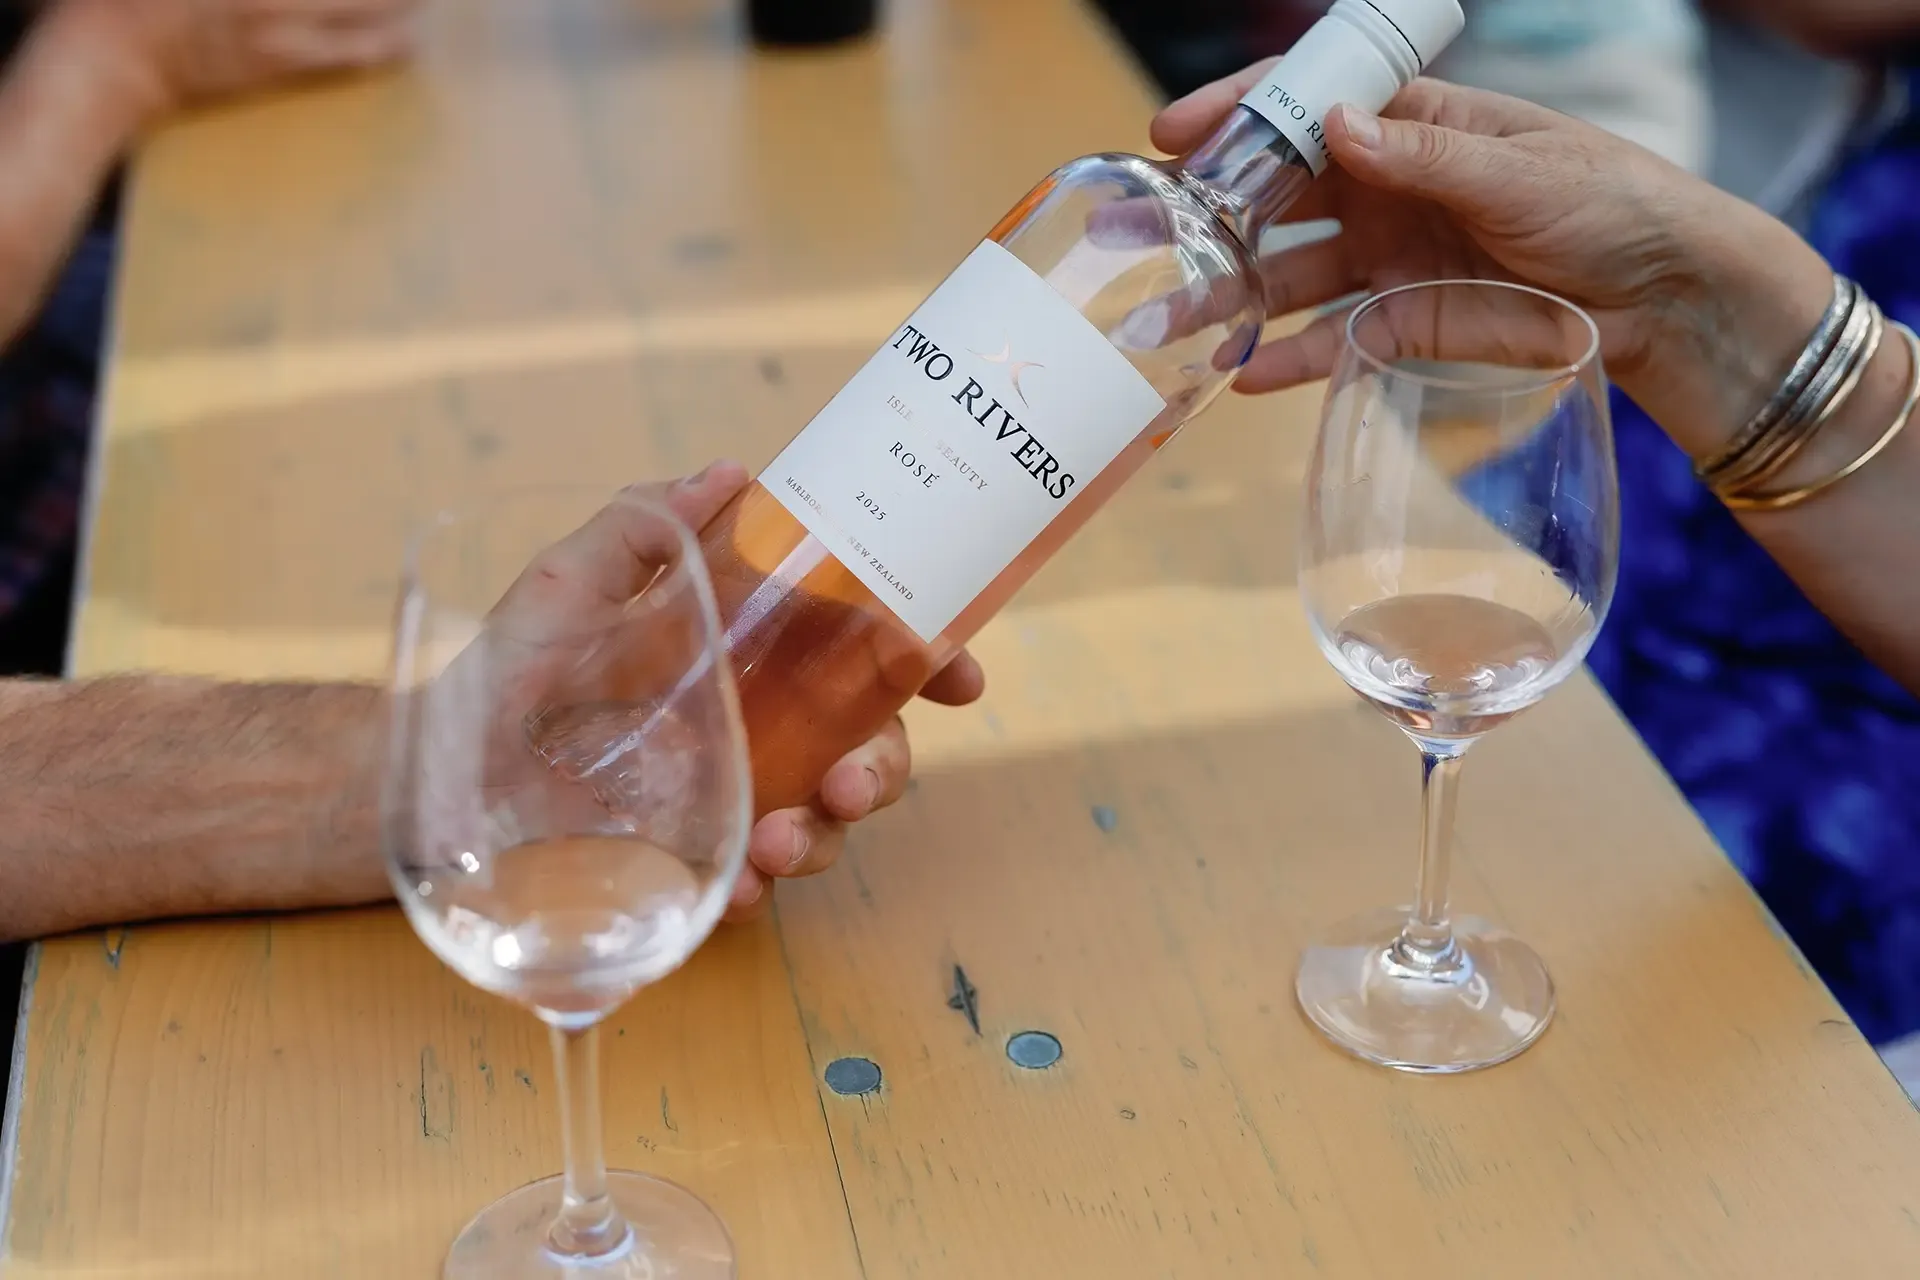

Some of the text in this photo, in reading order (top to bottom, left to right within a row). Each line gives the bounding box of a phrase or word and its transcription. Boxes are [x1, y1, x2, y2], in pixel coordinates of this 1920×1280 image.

[1266, 84, 1306, 121] TWO
[886, 395, 913, 422] ISLE
[892, 325, 1076, 500] TWO RIVERS
[889, 441, 940, 488] ROSÉ
[855, 490, 887, 521] 2025
[846, 536, 871, 558] NEW
[869, 557, 914, 601] ZEALAND
